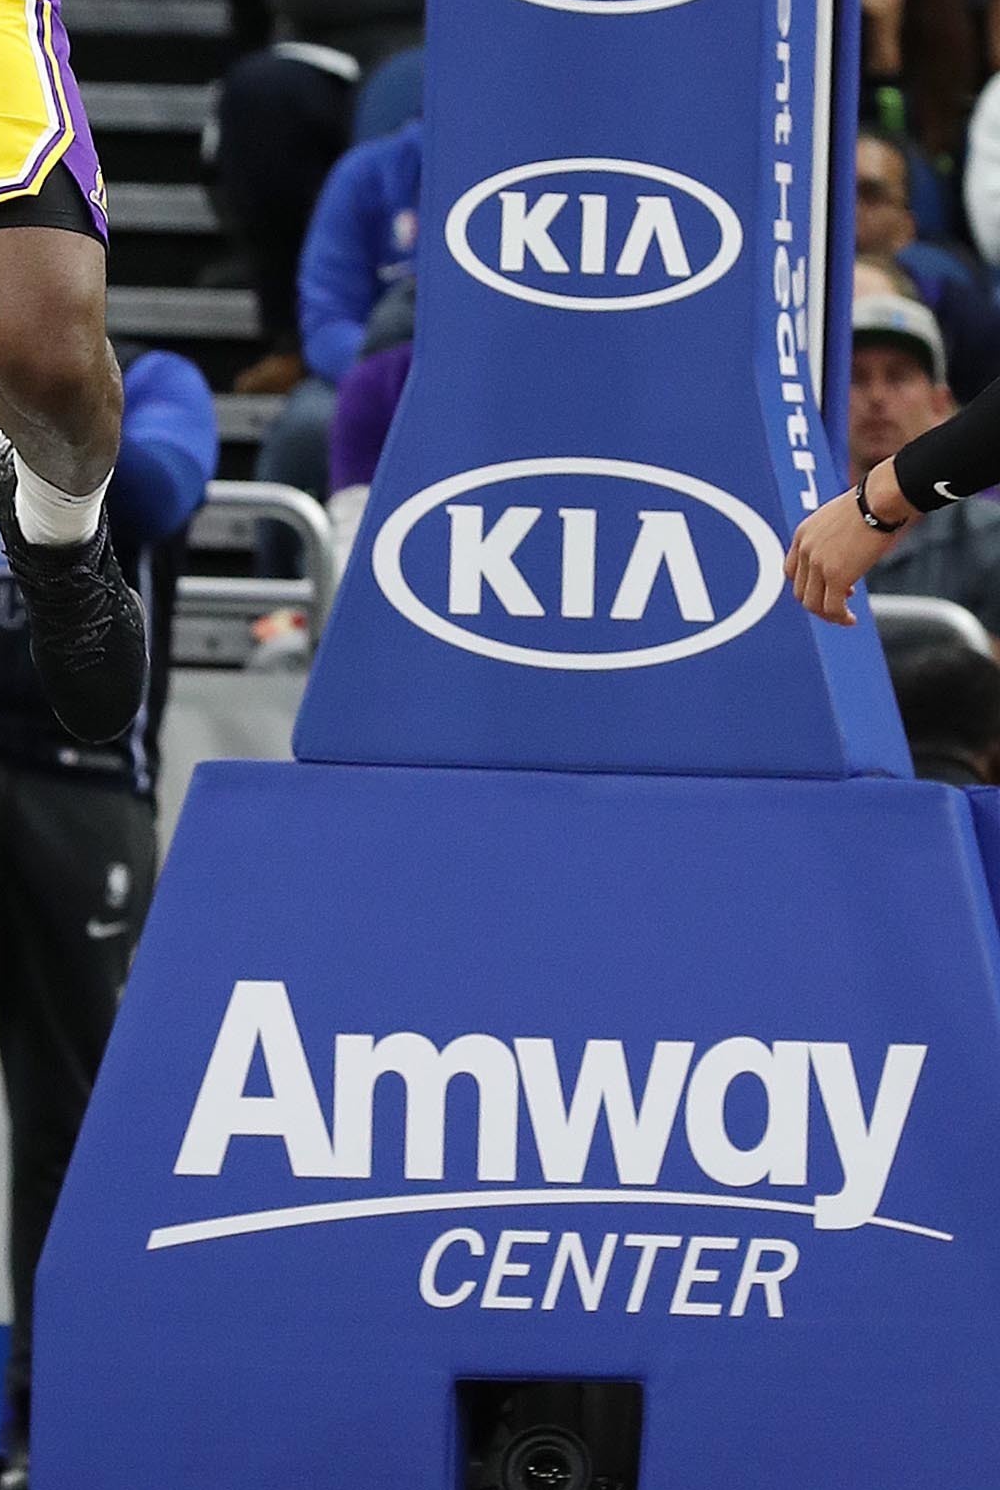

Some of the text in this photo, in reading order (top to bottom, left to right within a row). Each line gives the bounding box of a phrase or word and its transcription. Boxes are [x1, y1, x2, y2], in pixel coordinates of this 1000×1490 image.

[498, 191, 692, 277] KIA
[446, 504, 716, 622] KIA
[173, 978, 928, 1231] Amway
[418, 1227, 801, 1319] CENTER
